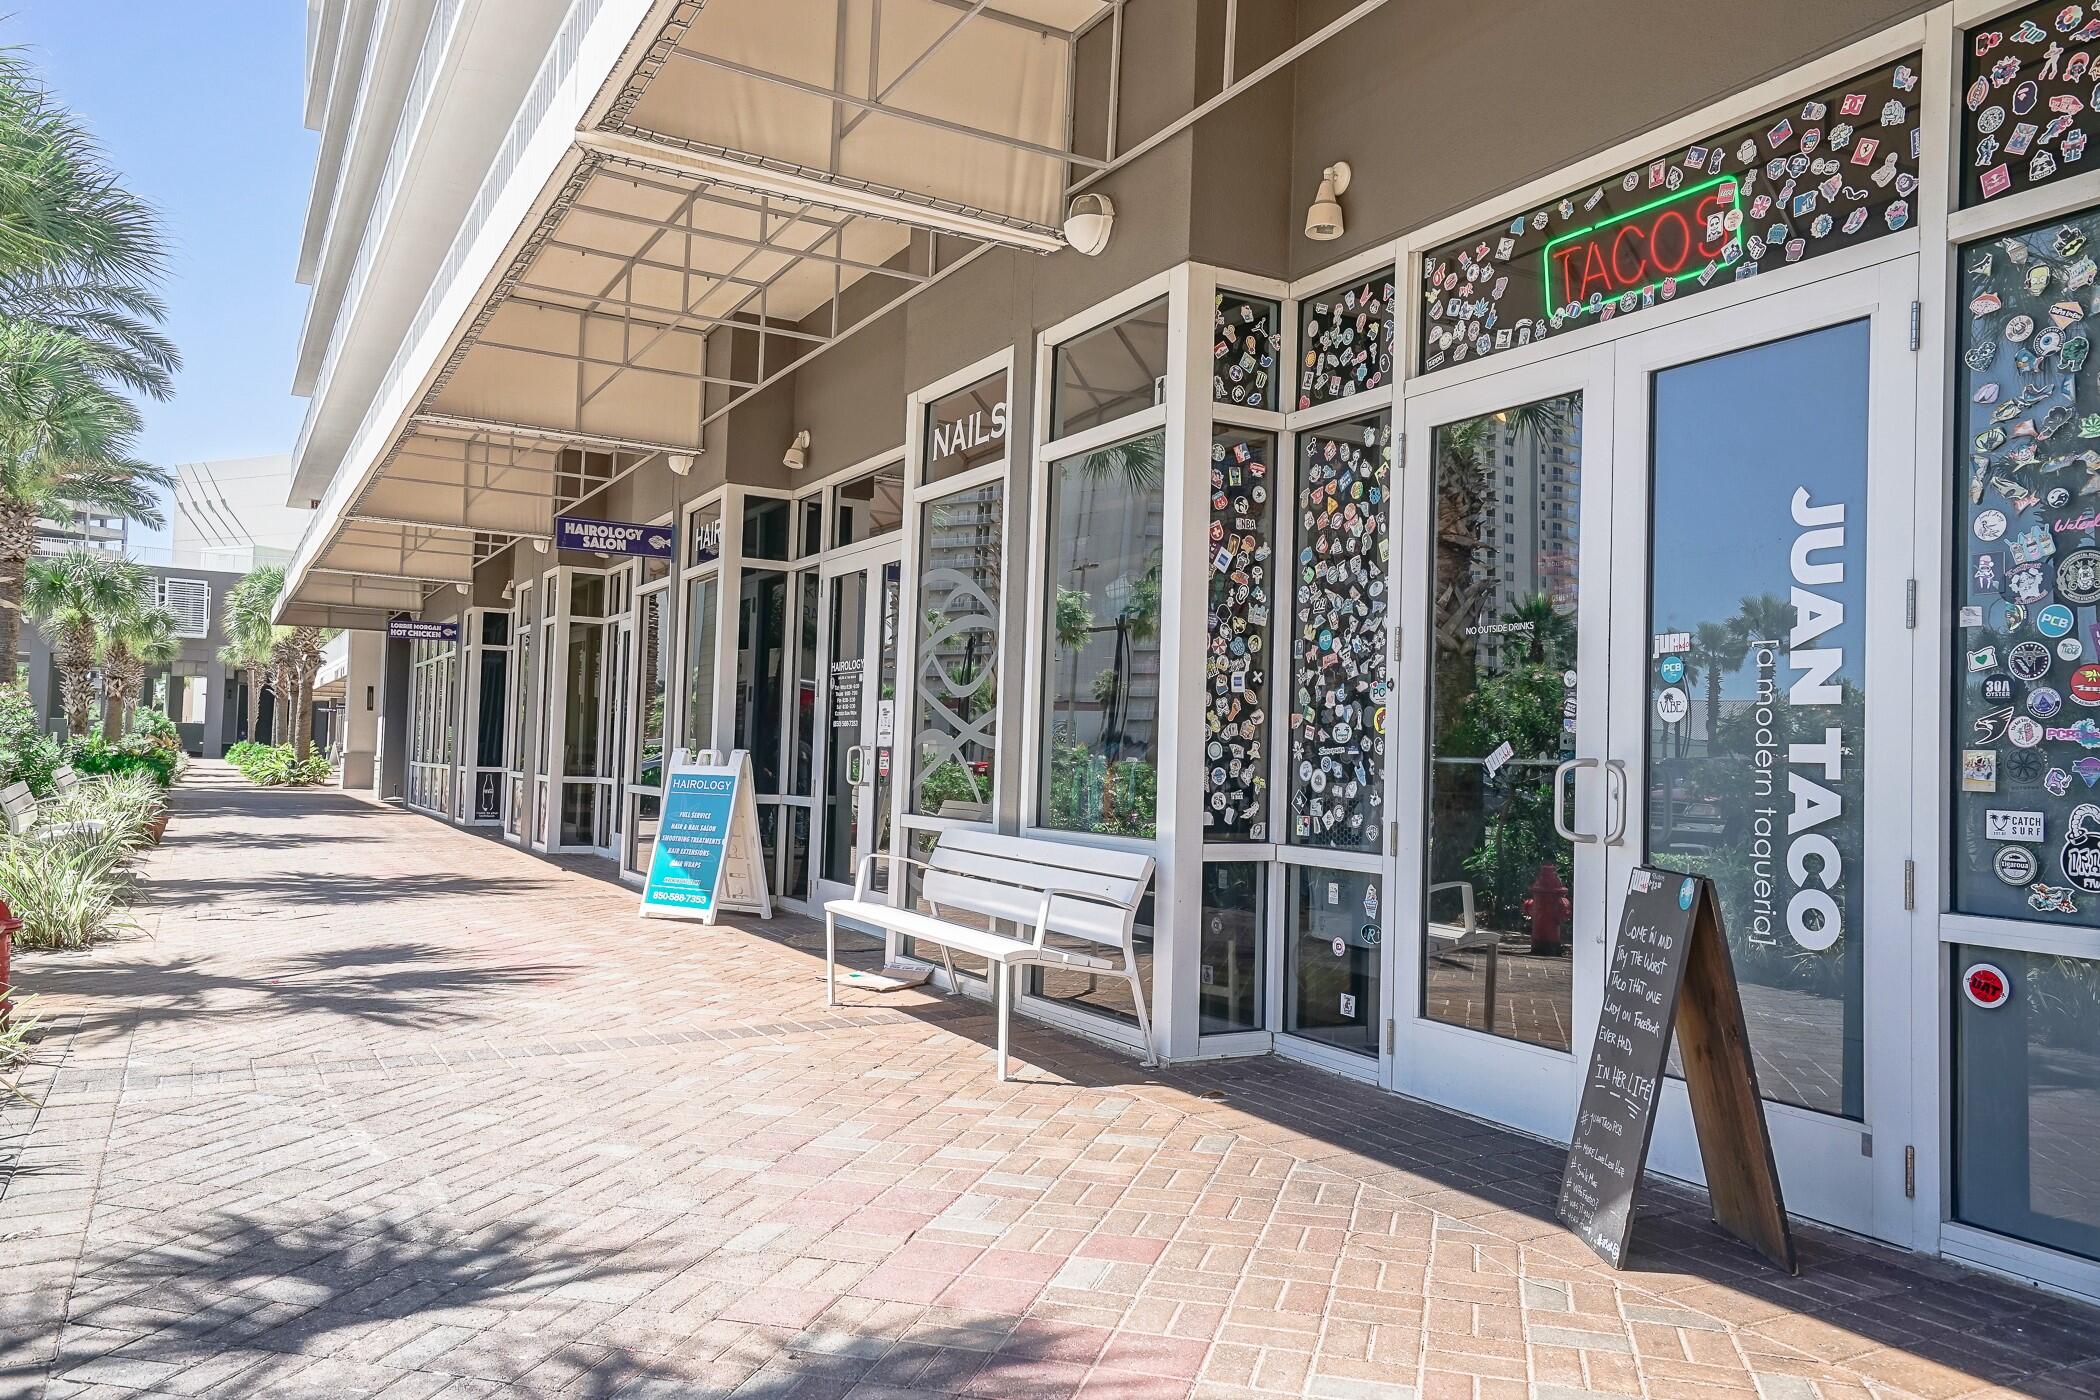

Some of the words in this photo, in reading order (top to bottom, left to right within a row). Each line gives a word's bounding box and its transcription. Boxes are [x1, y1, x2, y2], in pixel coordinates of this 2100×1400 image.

[1553, 195, 1729, 304] TACOS
[932, 402, 1007, 461] NAILS
[565, 522, 643, 541] HAIROLOGY
[583, 535, 627, 551] SALON
[1789, 486, 1845, 706] JUAN
[1465, 626, 1477, 635] NO
[1477, 624, 1508, 634] OUTSIDE
[1508, 621, 1535, 632] DRINKS
[2040, 612, 2069, 629] PCB
[407, 630, 441, 638] CHICKEN
[831, 659, 865, 672] HAIROLOGY
[1663, 663, 1681, 672] PCB
[1985, 680, 2010, 692] 30A
[1754, 680, 1779, 798] modern
[673, 779, 732, 791] HAIROLOGY
[691, 811, 711, 819] SERVICE
[2012, 816, 2041, 826] CATCH
[2012, 826, 2041, 836] SURF
[662, 834, 690, 842] SMOOTHING
[690, 836, 721, 845] TREATMENTS
[1785, 728, 1842, 951] TACO
[680, 848, 710, 857] EXTENSIONS
[683, 860, 702, 868] WRAPS
[1658, 934, 1673, 950] AND
[1631, 950, 1643, 966] THE
[1611, 970, 1627, 991] TACO
[1646, 991, 1662, 1005] ONE
[1604, 993, 1621, 1023] LADY
[1599, 1025, 1616, 1044] EVER
[1595, 1064, 1610, 1080] IN
[1612, 1065, 1627, 1089] HER
